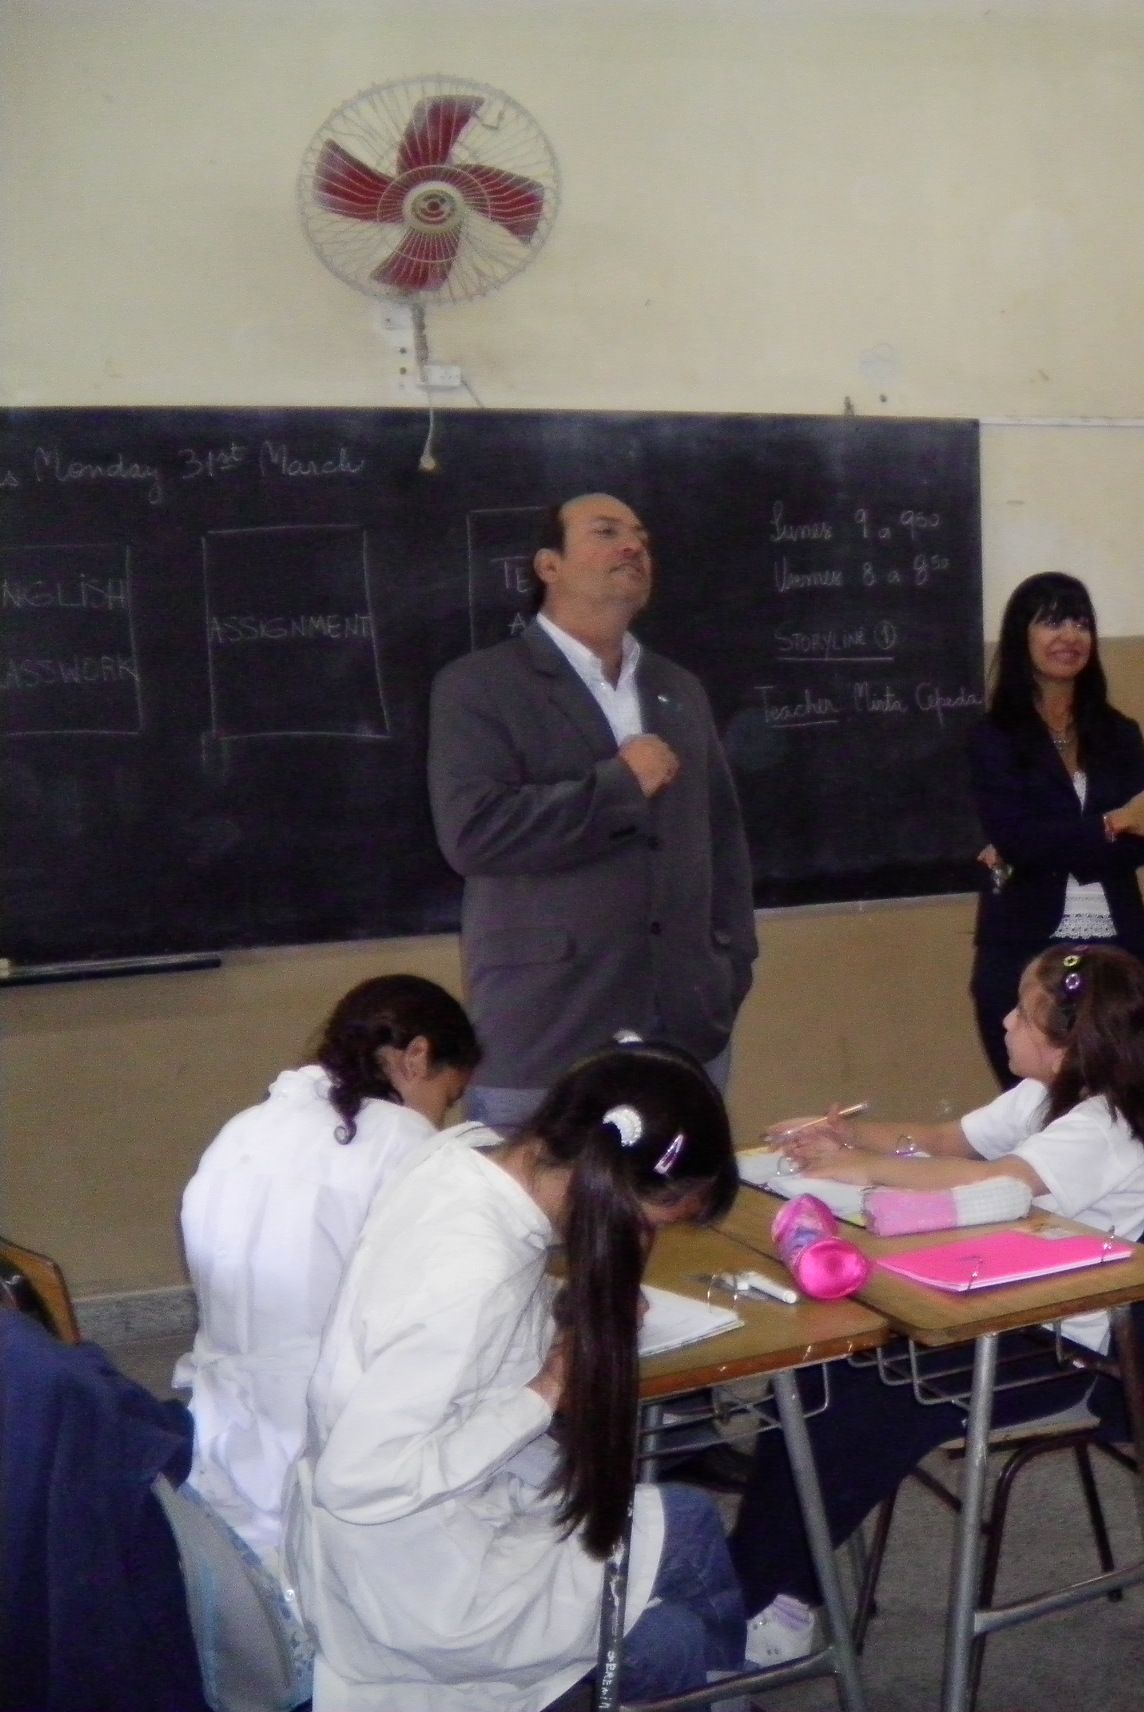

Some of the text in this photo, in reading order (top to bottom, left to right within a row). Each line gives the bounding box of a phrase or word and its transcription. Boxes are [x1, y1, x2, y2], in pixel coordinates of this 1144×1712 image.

[33, 446, 165, 505] Monday
[177, 442, 246, 479] 31st
[259, 440, 365, 477] March
[854, 508, 869, 539] 9
[489, 554, 530, 594] TE
[861, 560, 877, 587] 8
[0, 573, 126, 610] NGLISH
[207, 614, 374, 645] ASSIGNMENT
[507, 612, 526, 635] A
[0, 655, 140, 690] ASSWORK
[753, 685, 841, 725] Teacher
[852, 679, 907, 714] Mirta
